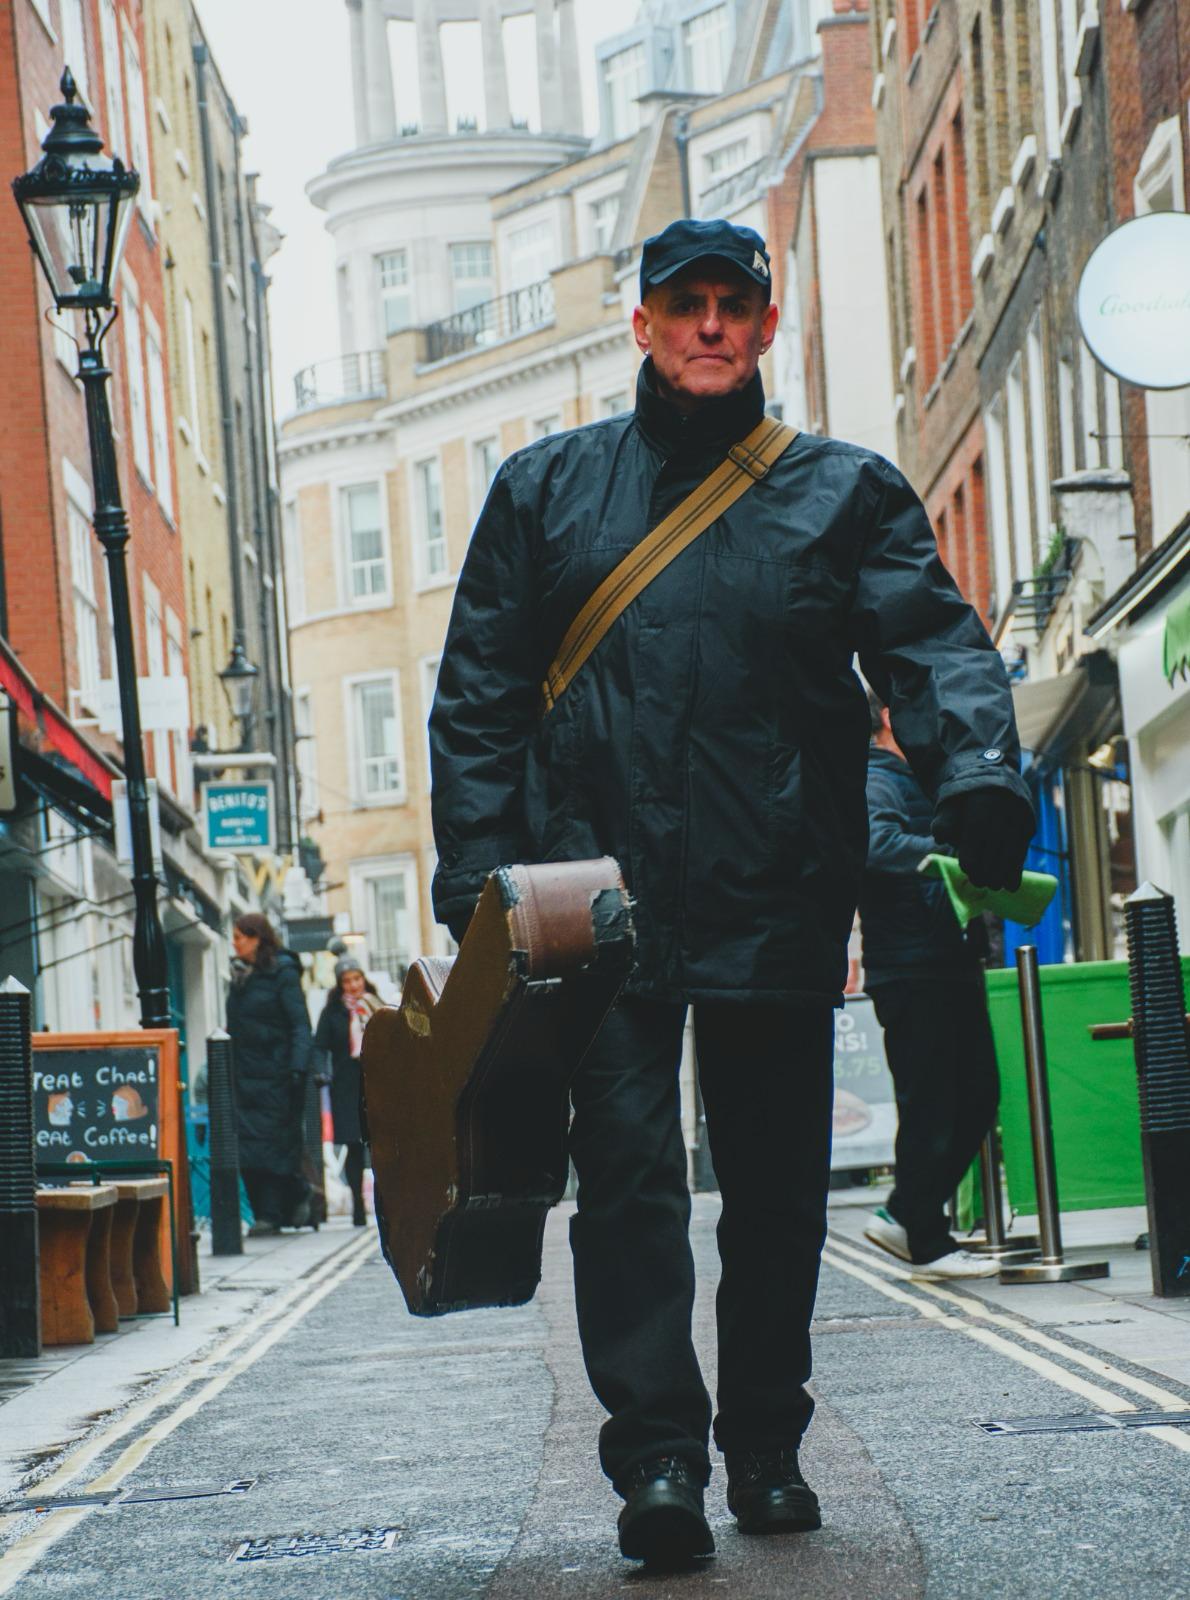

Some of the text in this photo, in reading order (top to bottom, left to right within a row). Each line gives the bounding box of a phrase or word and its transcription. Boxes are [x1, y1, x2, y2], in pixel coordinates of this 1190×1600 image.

[33, 1072, 83, 1092] reat
[36, 1124, 157, 1149] eat Coffee!
